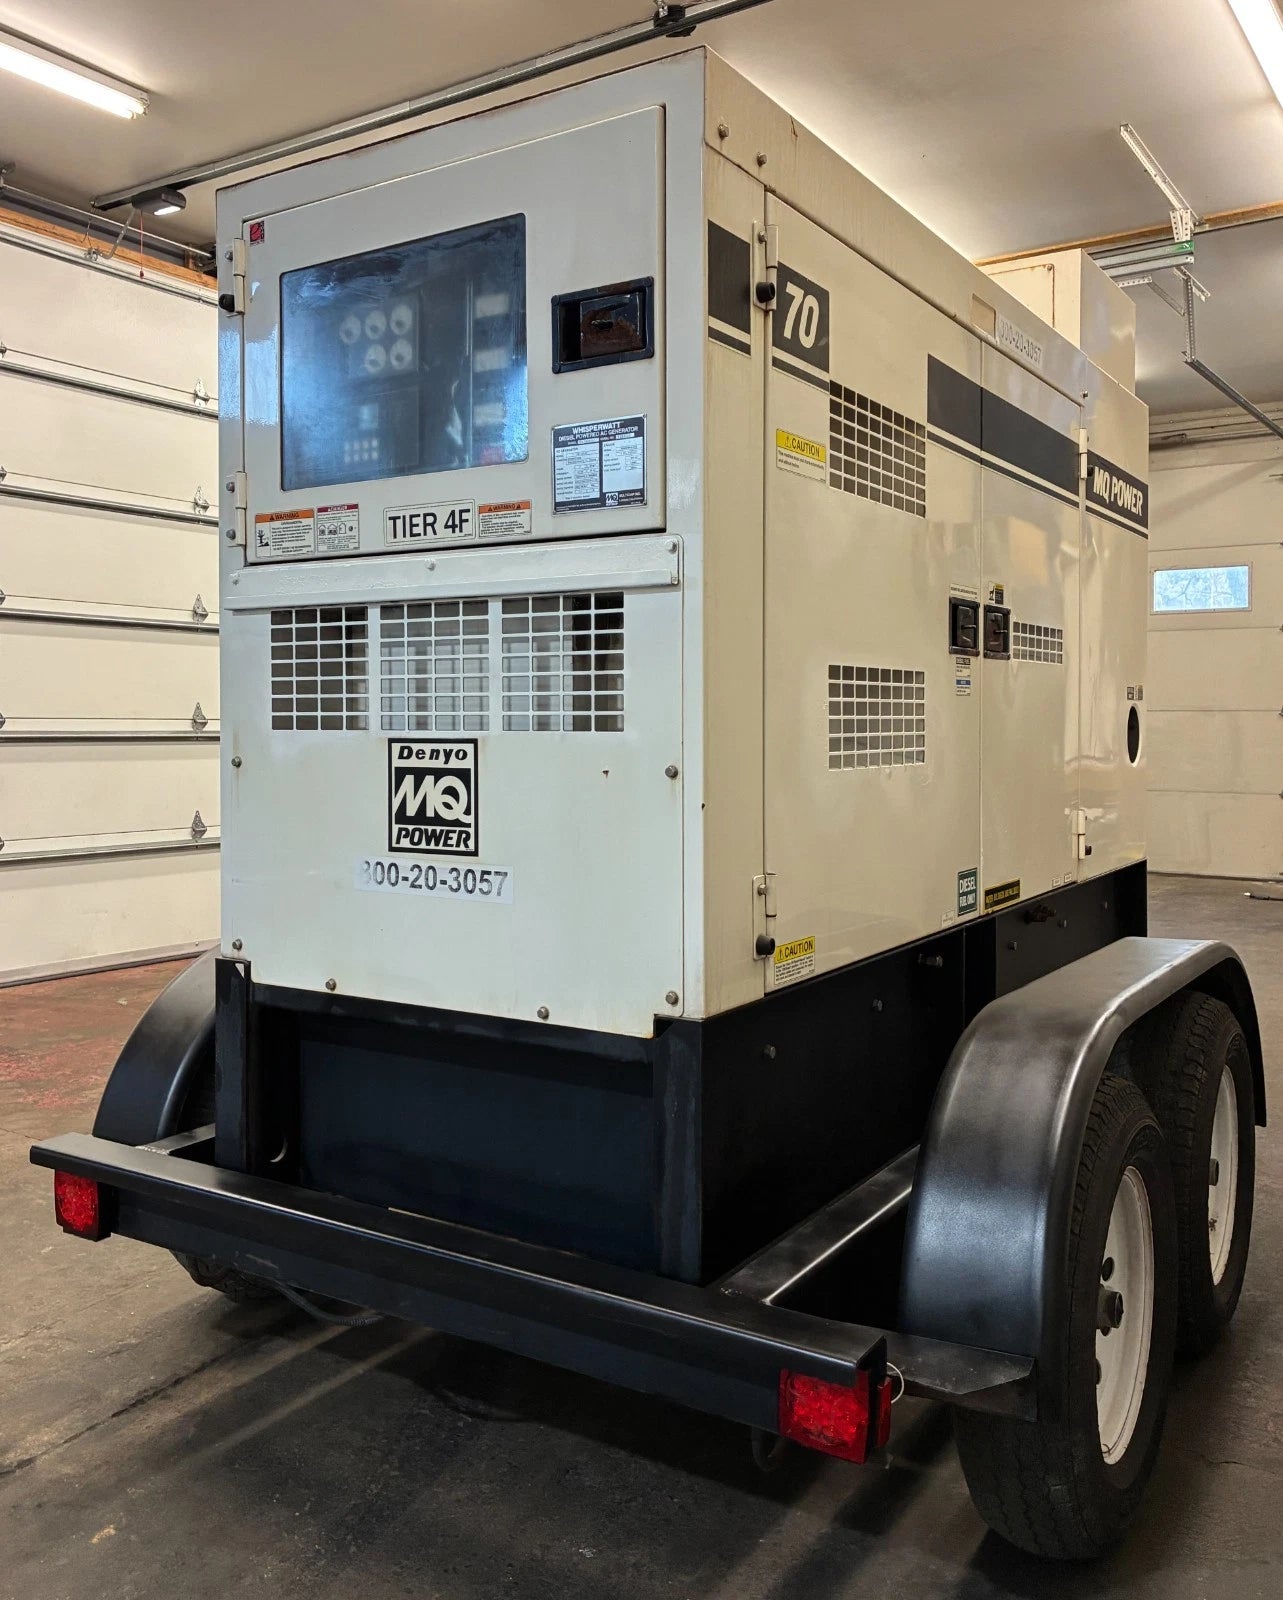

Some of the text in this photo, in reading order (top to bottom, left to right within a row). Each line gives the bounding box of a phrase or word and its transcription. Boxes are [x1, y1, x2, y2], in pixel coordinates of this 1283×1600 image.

[784, 281, 820, 349] 70
[558, 433, 575, 442] DIESEL
[575, 430, 599, 440] POWERED
[600, 430, 608, 438] AC
[608, 425, 639, 437] GENERATOR
[572, 421, 621, 434] WHISPERWATT
[791, 437, 820, 458] CAUTION
[1093, 466, 1143, 516] MQ POWER
[275, 511, 300, 520] WARNING
[388, 512, 438, 539] TIER
[444, 508, 471, 534] 4F
[397, 745, 468, 764] Denyo
[394, 774, 472, 824] MQ
[395, 826, 472, 849] POWER
[959, 876, 977, 894] DIESEL
[784, 939, 814, 958] CAUTION
